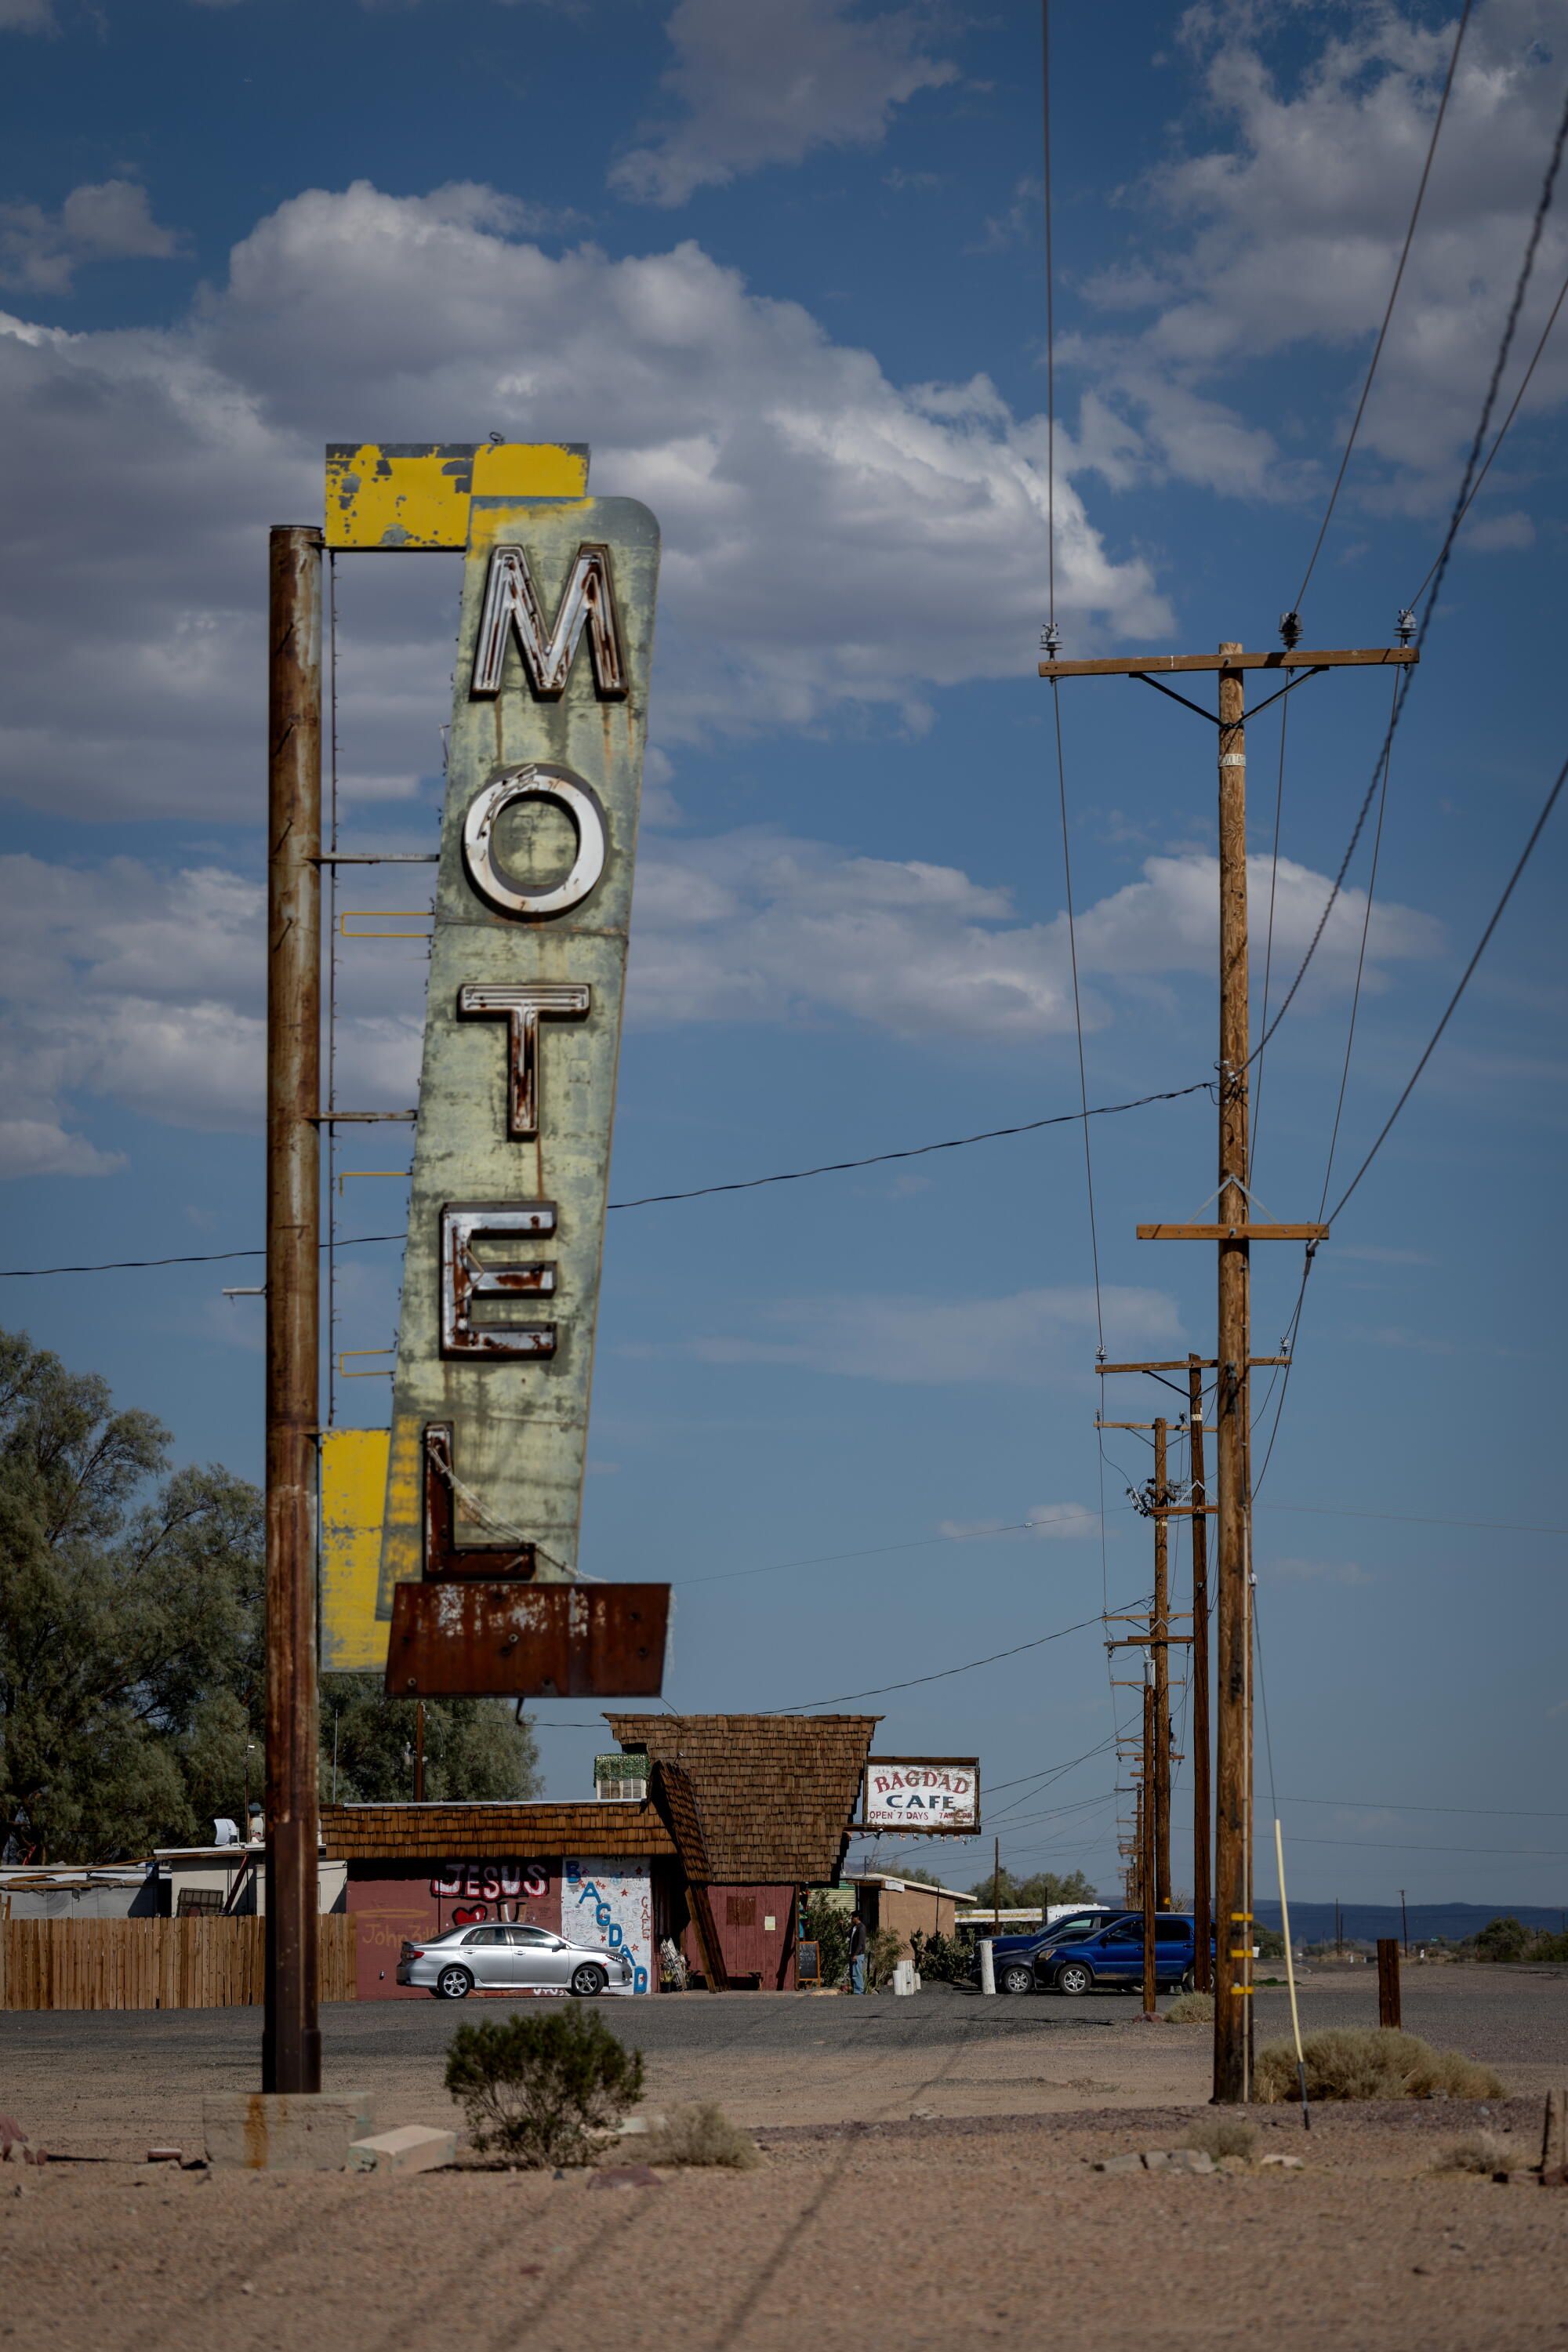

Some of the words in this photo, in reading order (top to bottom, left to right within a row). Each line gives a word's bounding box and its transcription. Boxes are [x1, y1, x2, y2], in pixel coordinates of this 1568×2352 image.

[423, 543, 628, 1582] MOTEL
[873, 1769, 970, 1795] BAGDAD
[869, 1811, 893, 1820] OPEN
[906, 1811, 929, 1820] DAYS
[886, 1795, 956, 1809] CAFE
[431, 1864, 548, 1900] JESUS
[565, 1860, 648, 1994] BAGDAD
[640, 1896, 651, 1940] CAFE
[362, 1923, 406, 1947] John
